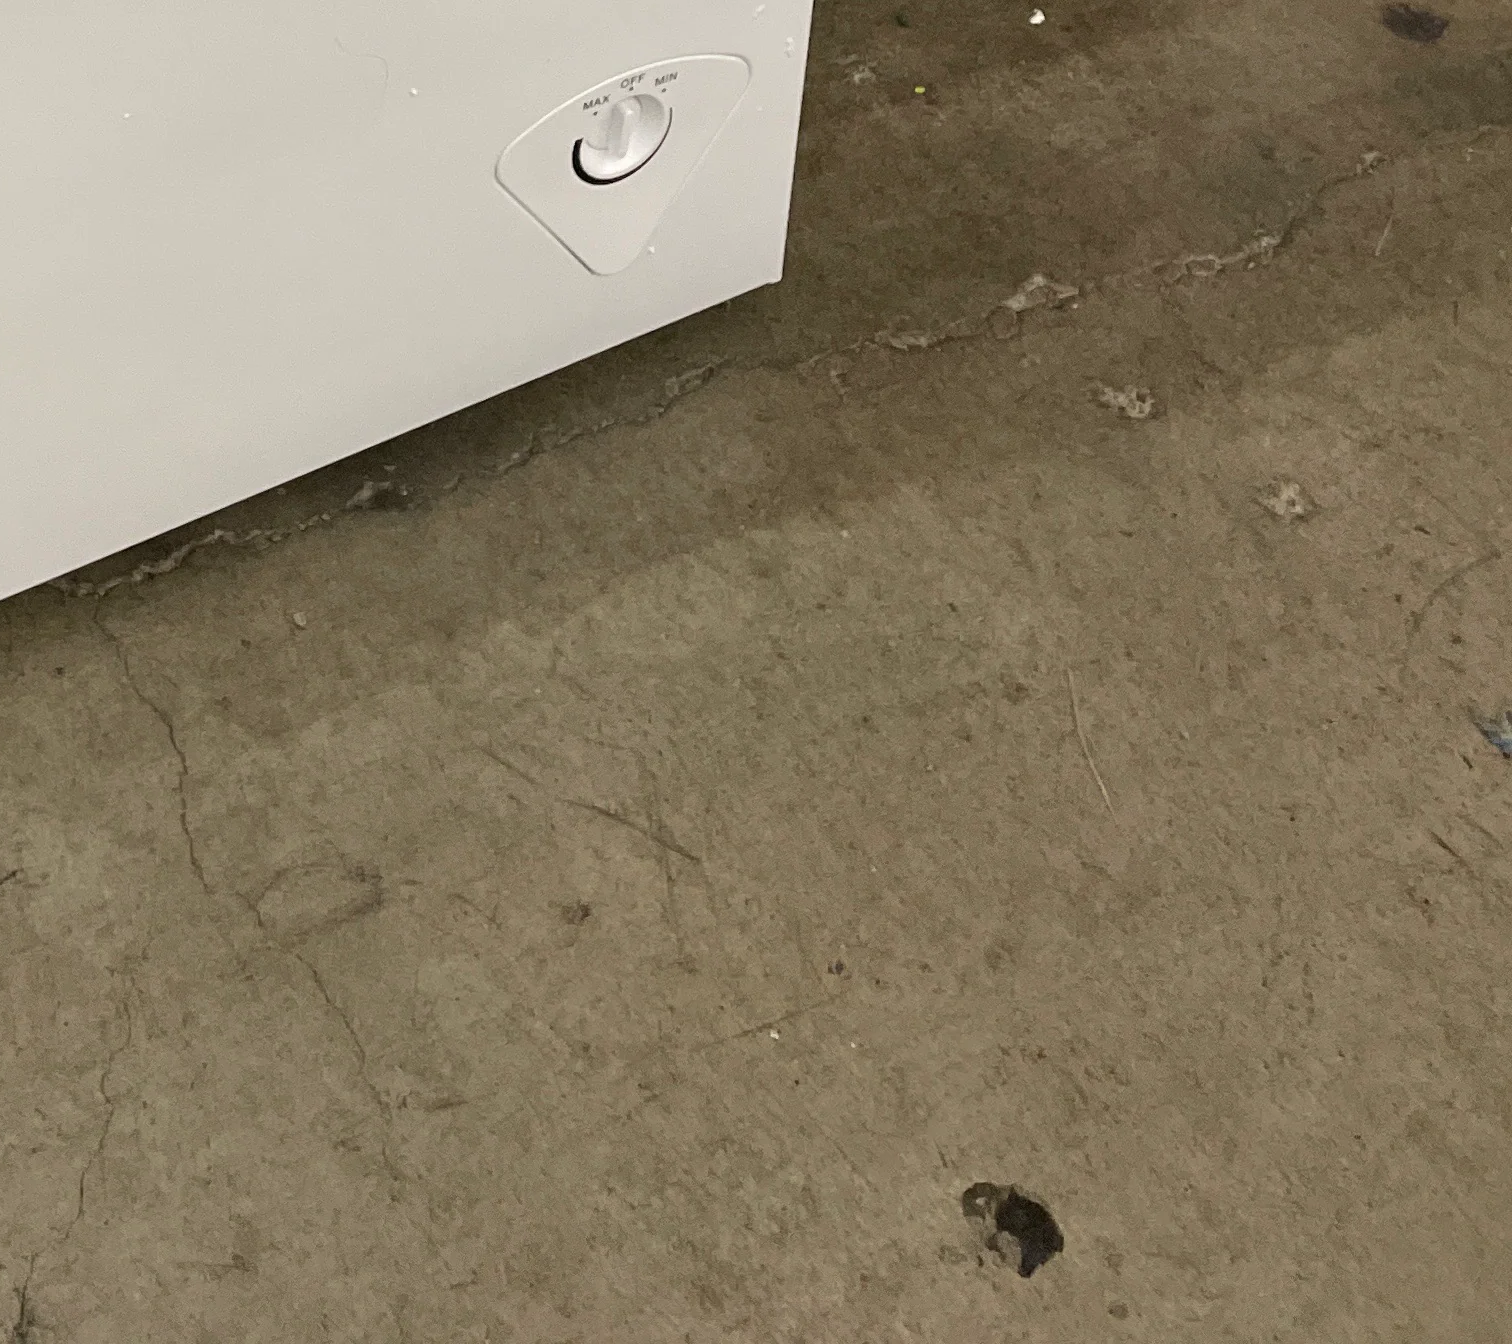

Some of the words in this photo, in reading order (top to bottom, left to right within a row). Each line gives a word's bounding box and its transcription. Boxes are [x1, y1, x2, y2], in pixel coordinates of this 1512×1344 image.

[620, 73, 646, 89] OFF
[654, 72, 678, 87] MIN
[582, 93, 612, 111] MAX
